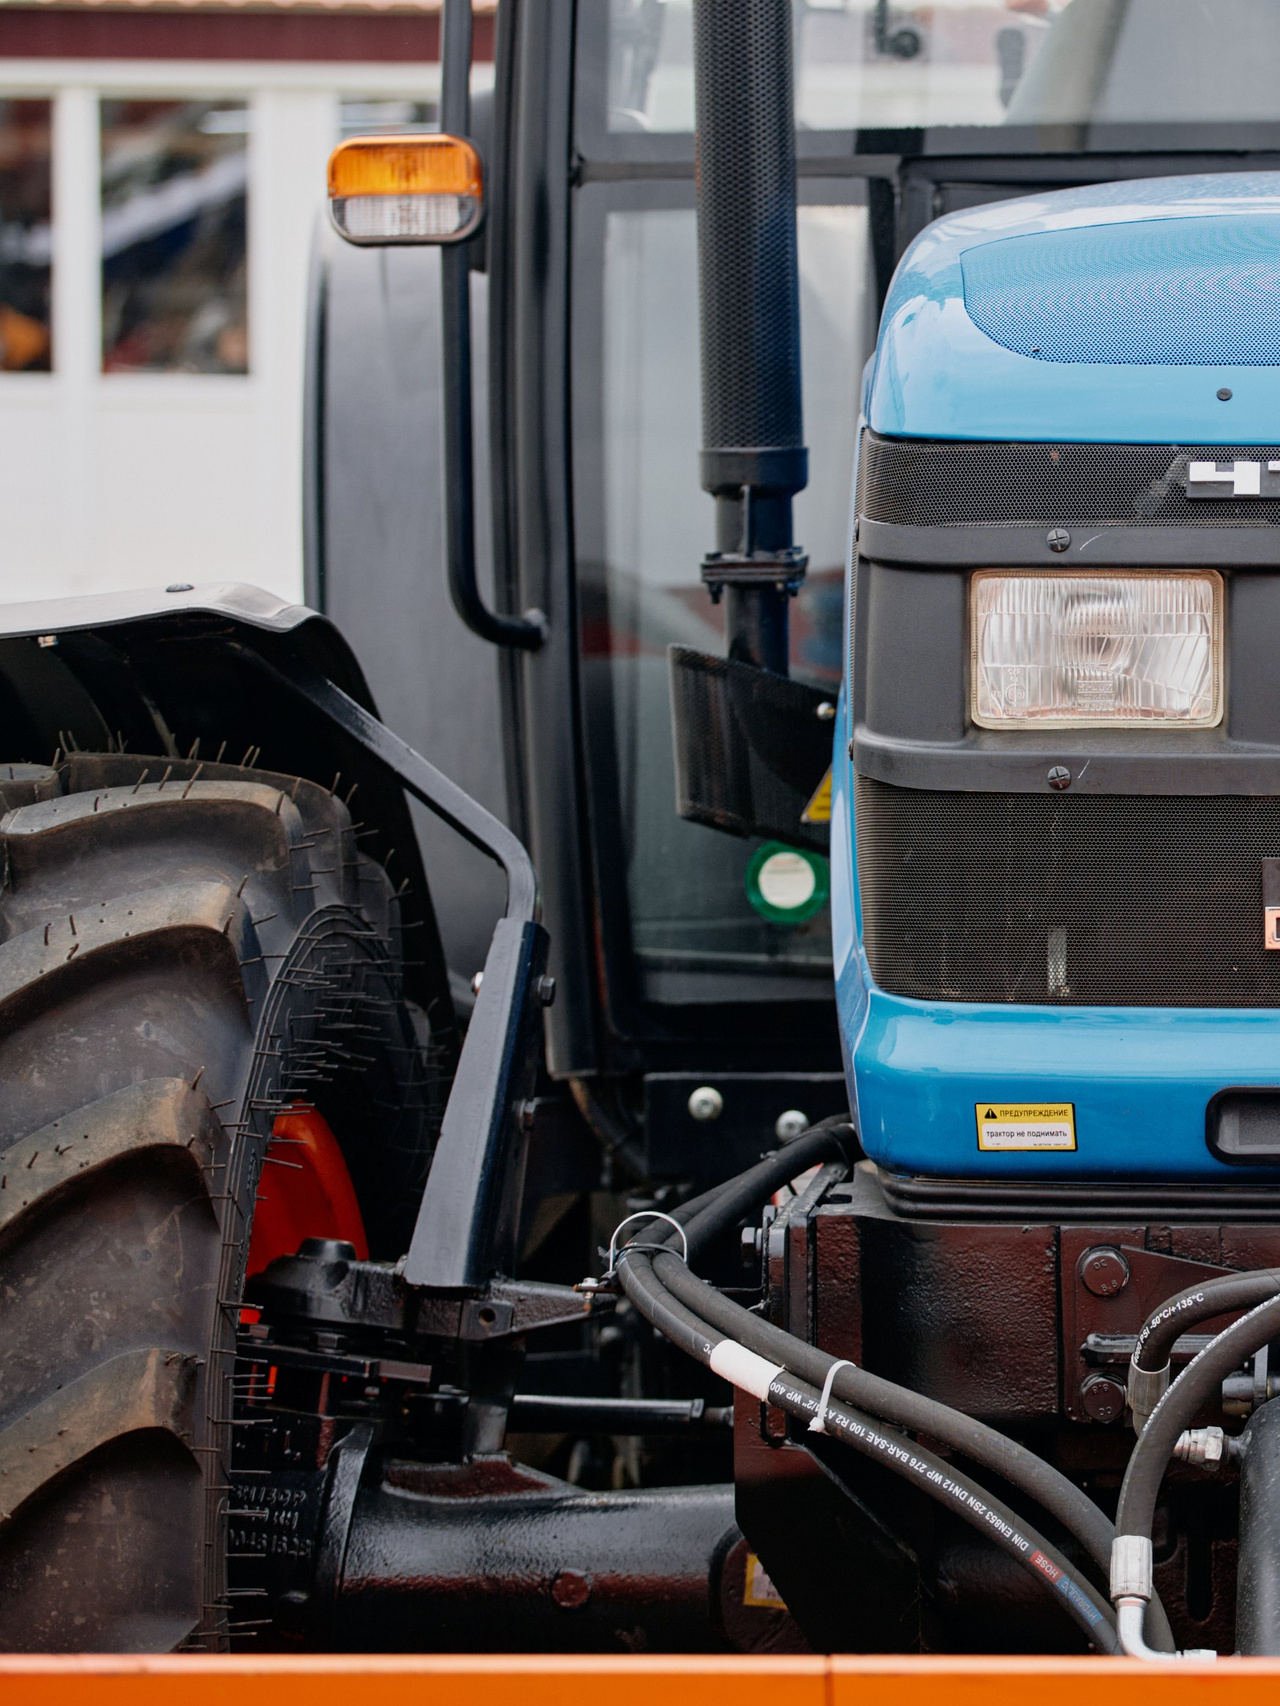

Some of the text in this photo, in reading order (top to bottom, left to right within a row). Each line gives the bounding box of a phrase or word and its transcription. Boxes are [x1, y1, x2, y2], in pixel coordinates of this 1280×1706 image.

[999, 1109, 1069, 1117] ПРЕДУПРЕЖДЕНИЕ
[986, 1130, 1015, 1139] трактор
[1027, 1130, 1067, 1138] поднимать
[769, 1381, 786, 1397] 400
[786, 1391, 803, 1405] WP
[835, 1413, 850, 1427] R2
[849, 1421, 866, 1437] 100
[865, 1431, 910, 1462] BAR-SAE
[908, 1457, 928, 1473] 276
[926, 1470, 944, 1485] WP
[942, 1478, 969, 1501] DN12
[966, 1496, 988, 1515] 2SN
[985, 1510, 1014, 1538] EN853
[1011, 1532, 1030, 1552] DIN
[1034, 1553, 1059, 1579] HOSE
[1060, 1580, 1098, 1621] HYDRAULIC
